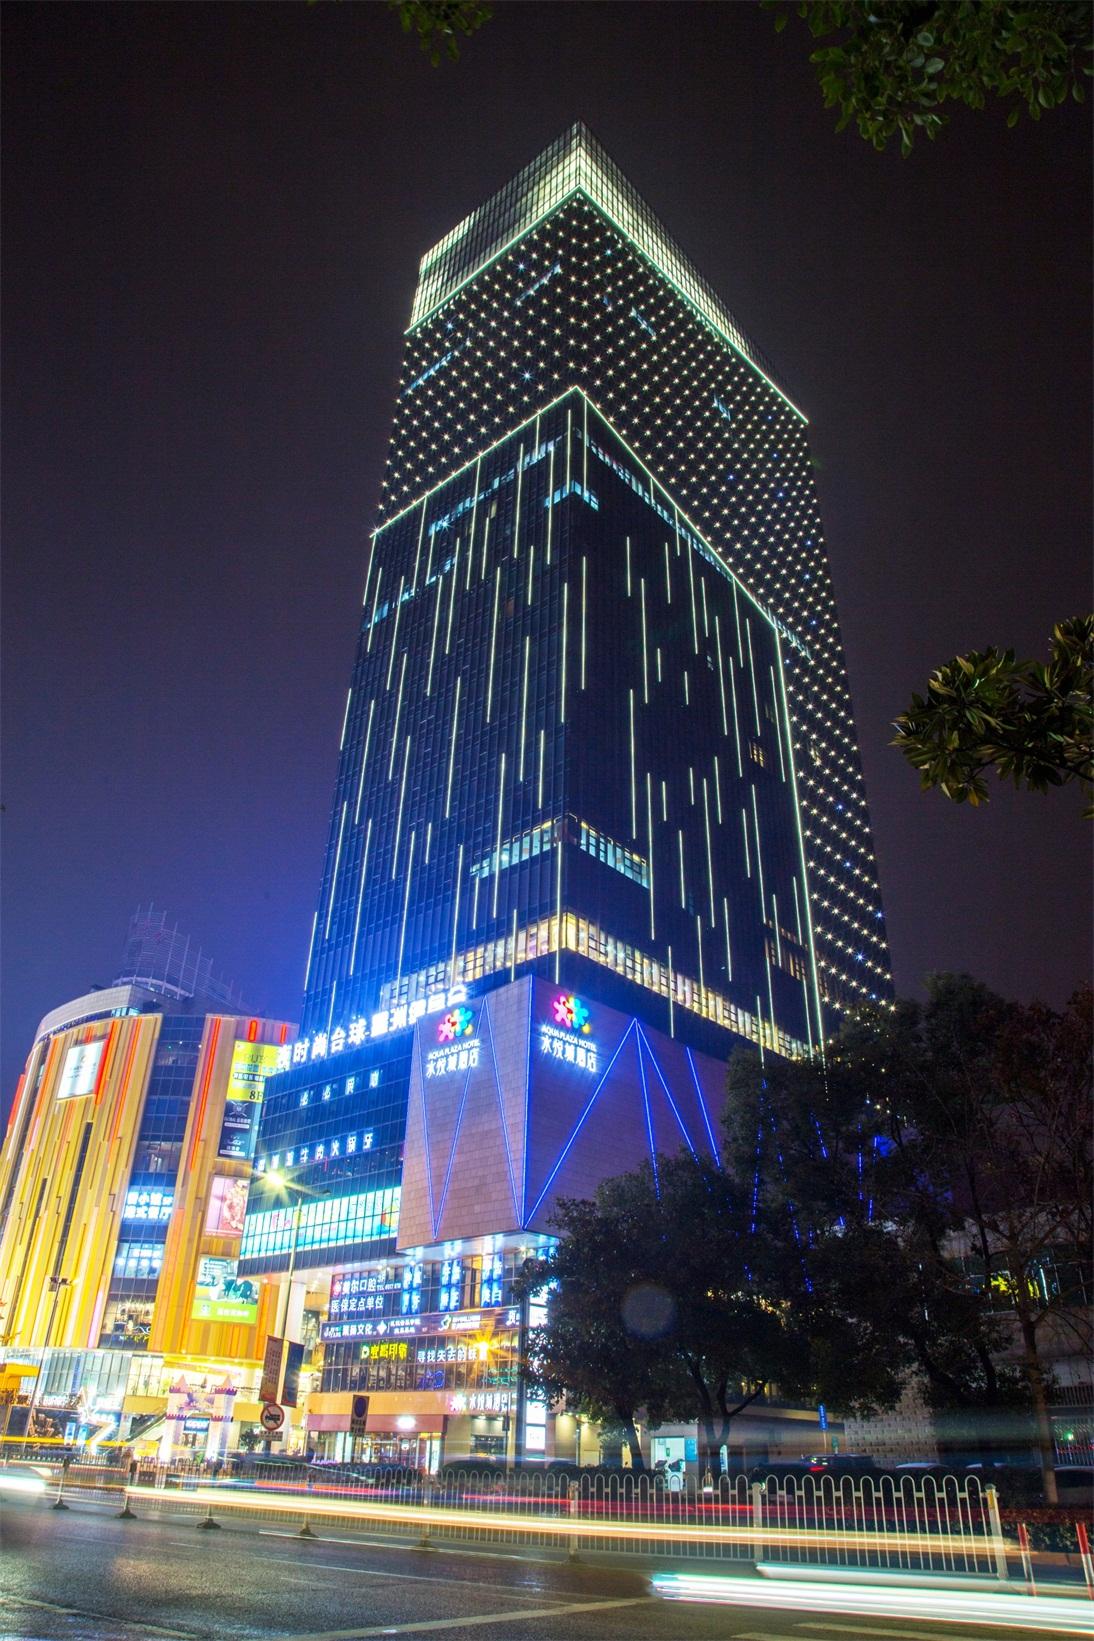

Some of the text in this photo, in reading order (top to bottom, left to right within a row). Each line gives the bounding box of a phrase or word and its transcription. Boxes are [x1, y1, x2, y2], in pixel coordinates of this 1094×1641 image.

[445, 1044, 463, 1055] PLAZA
[463, 1038, 481, 1049] HOTEL
[560, 1031, 578, 1044] PLAZA
[578, 1039, 597, 1052] HOTEL
[331, 1295, 383, 1312] 医保定点单位
